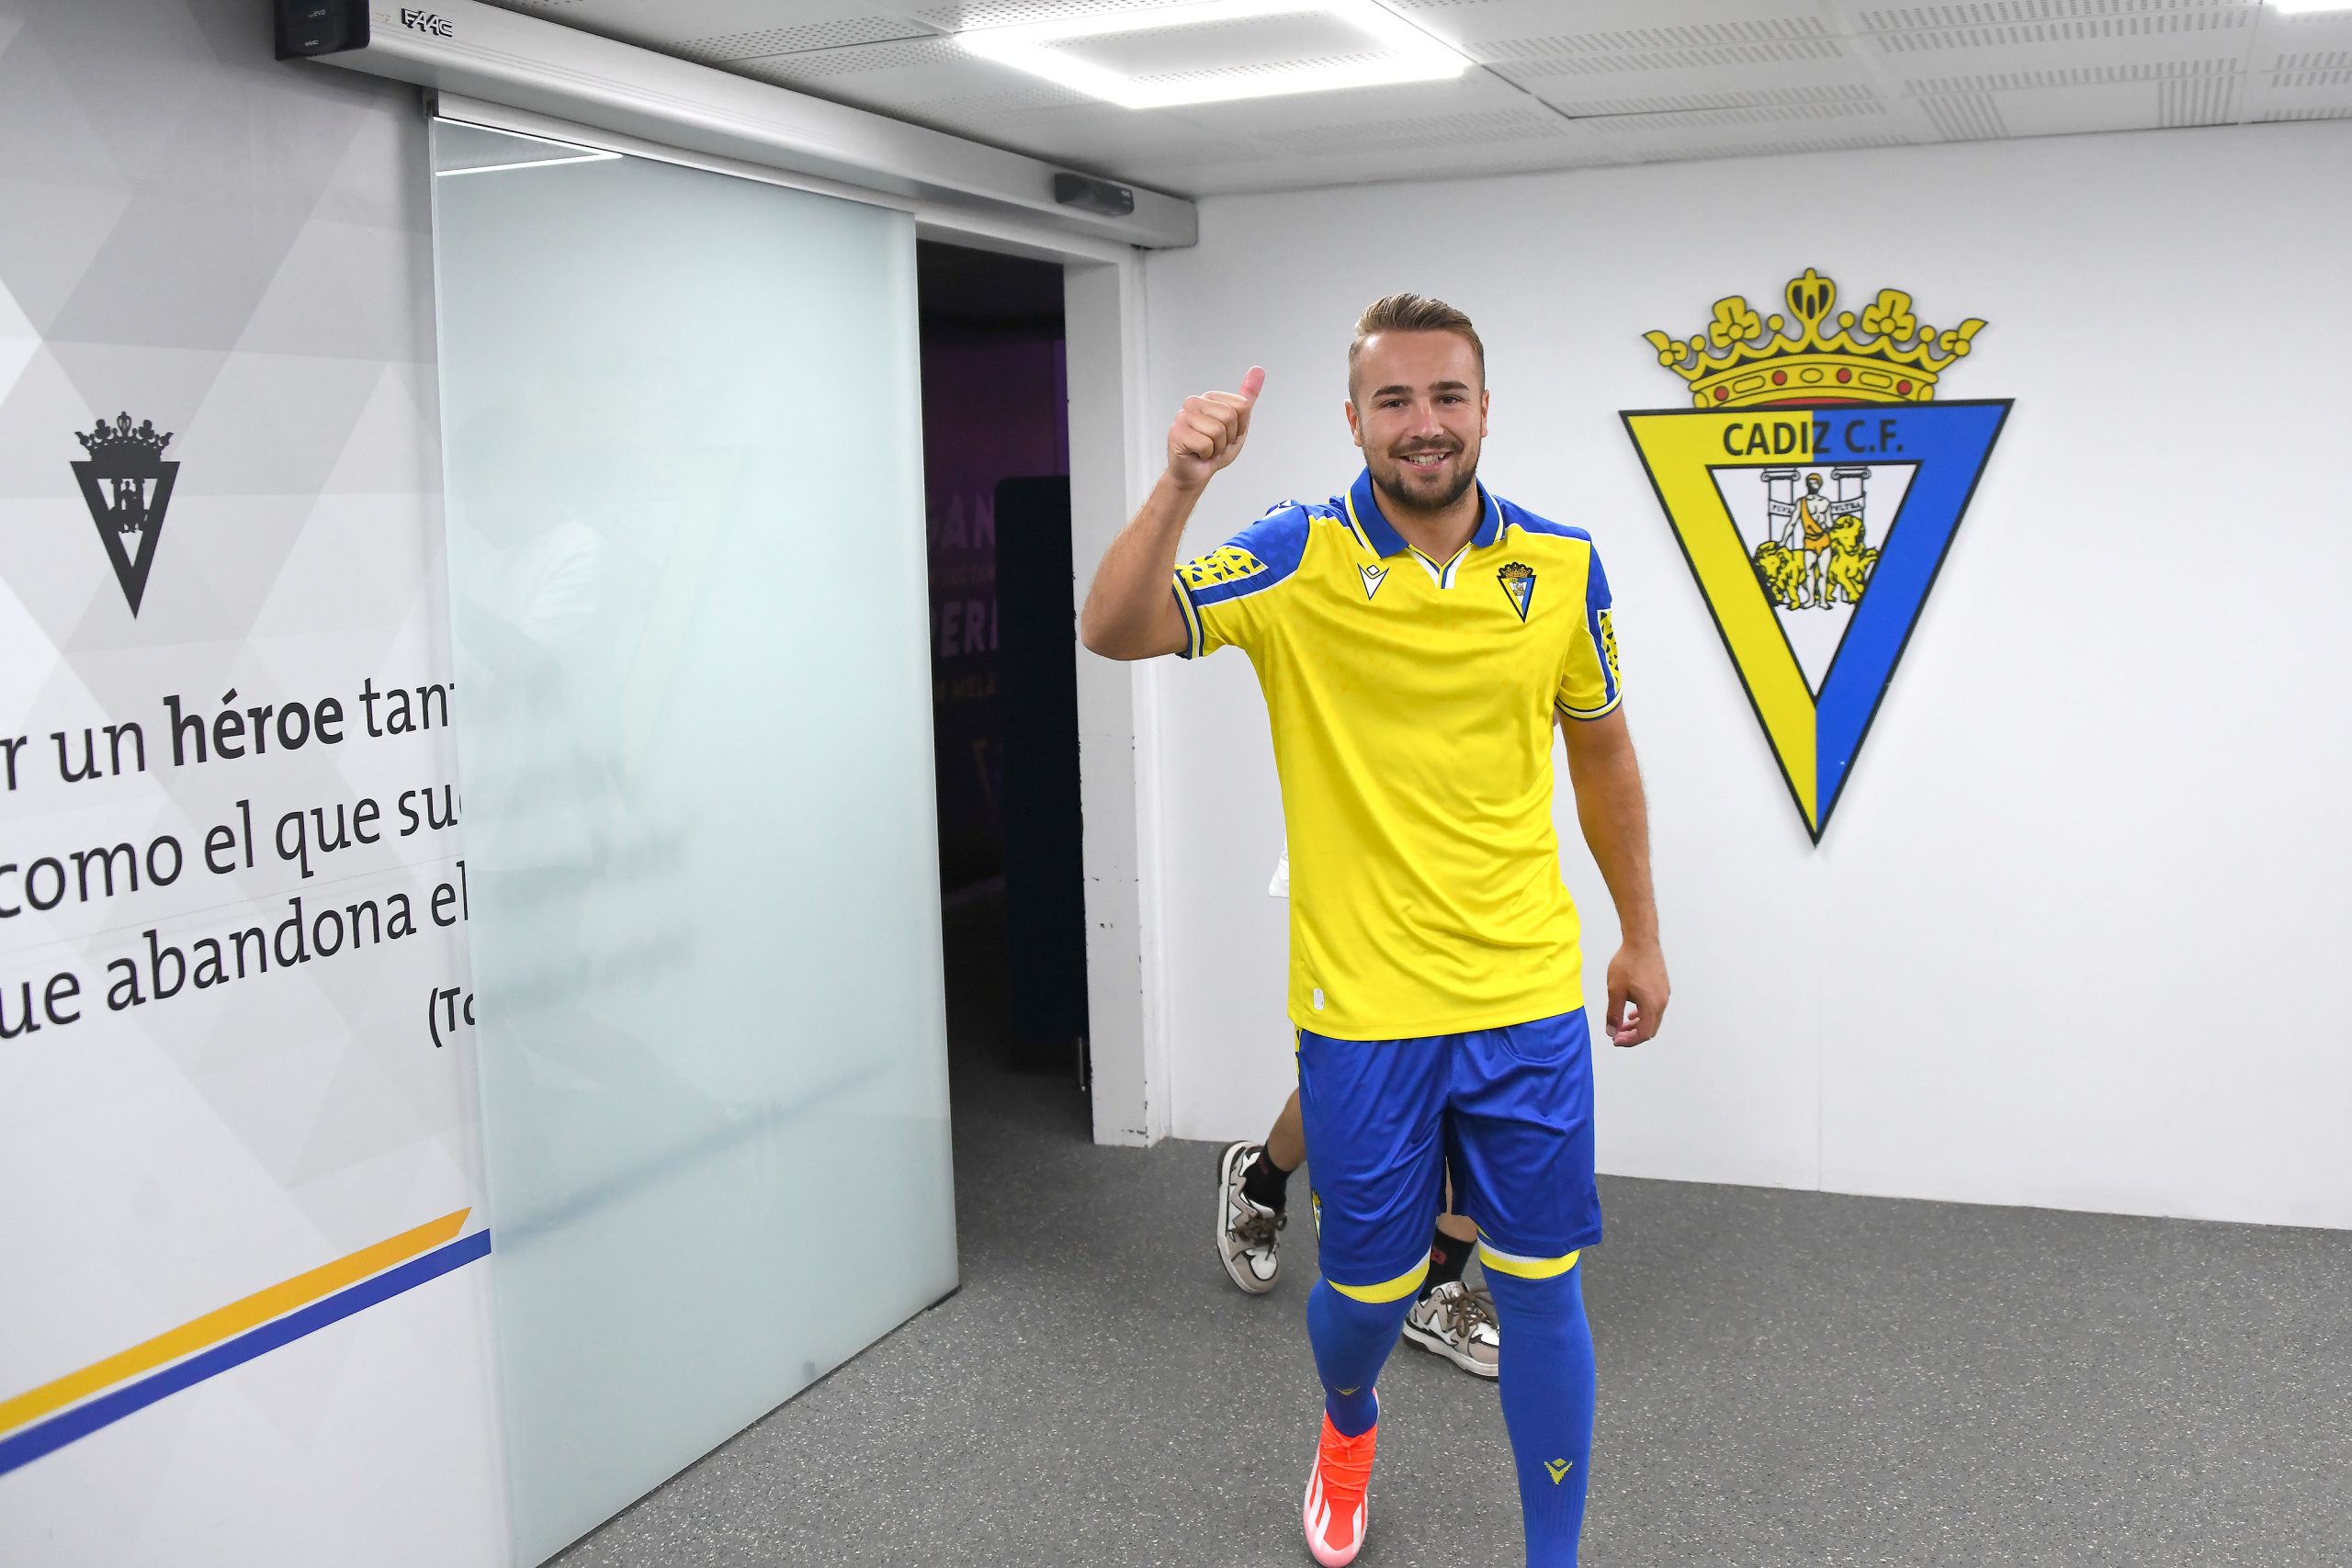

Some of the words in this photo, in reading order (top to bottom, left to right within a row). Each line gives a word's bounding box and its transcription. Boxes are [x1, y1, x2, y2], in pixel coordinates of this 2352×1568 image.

[401, 8, 453, 38] FAAC
[1723, 421, 1831, 457] CADIZ
[50, 721, 146, 784] un
[163, 687, 345, 768] héroe
[358, 677, 456, 738] tan
[0, 835, 184, 919] como
[204, 798, 254, 874] el
[275, 796, 381, 880] que
[398, 784, 462, 837] su
[106, 893, 418, 1011] abandona
[430, 860, 469, 928] el
